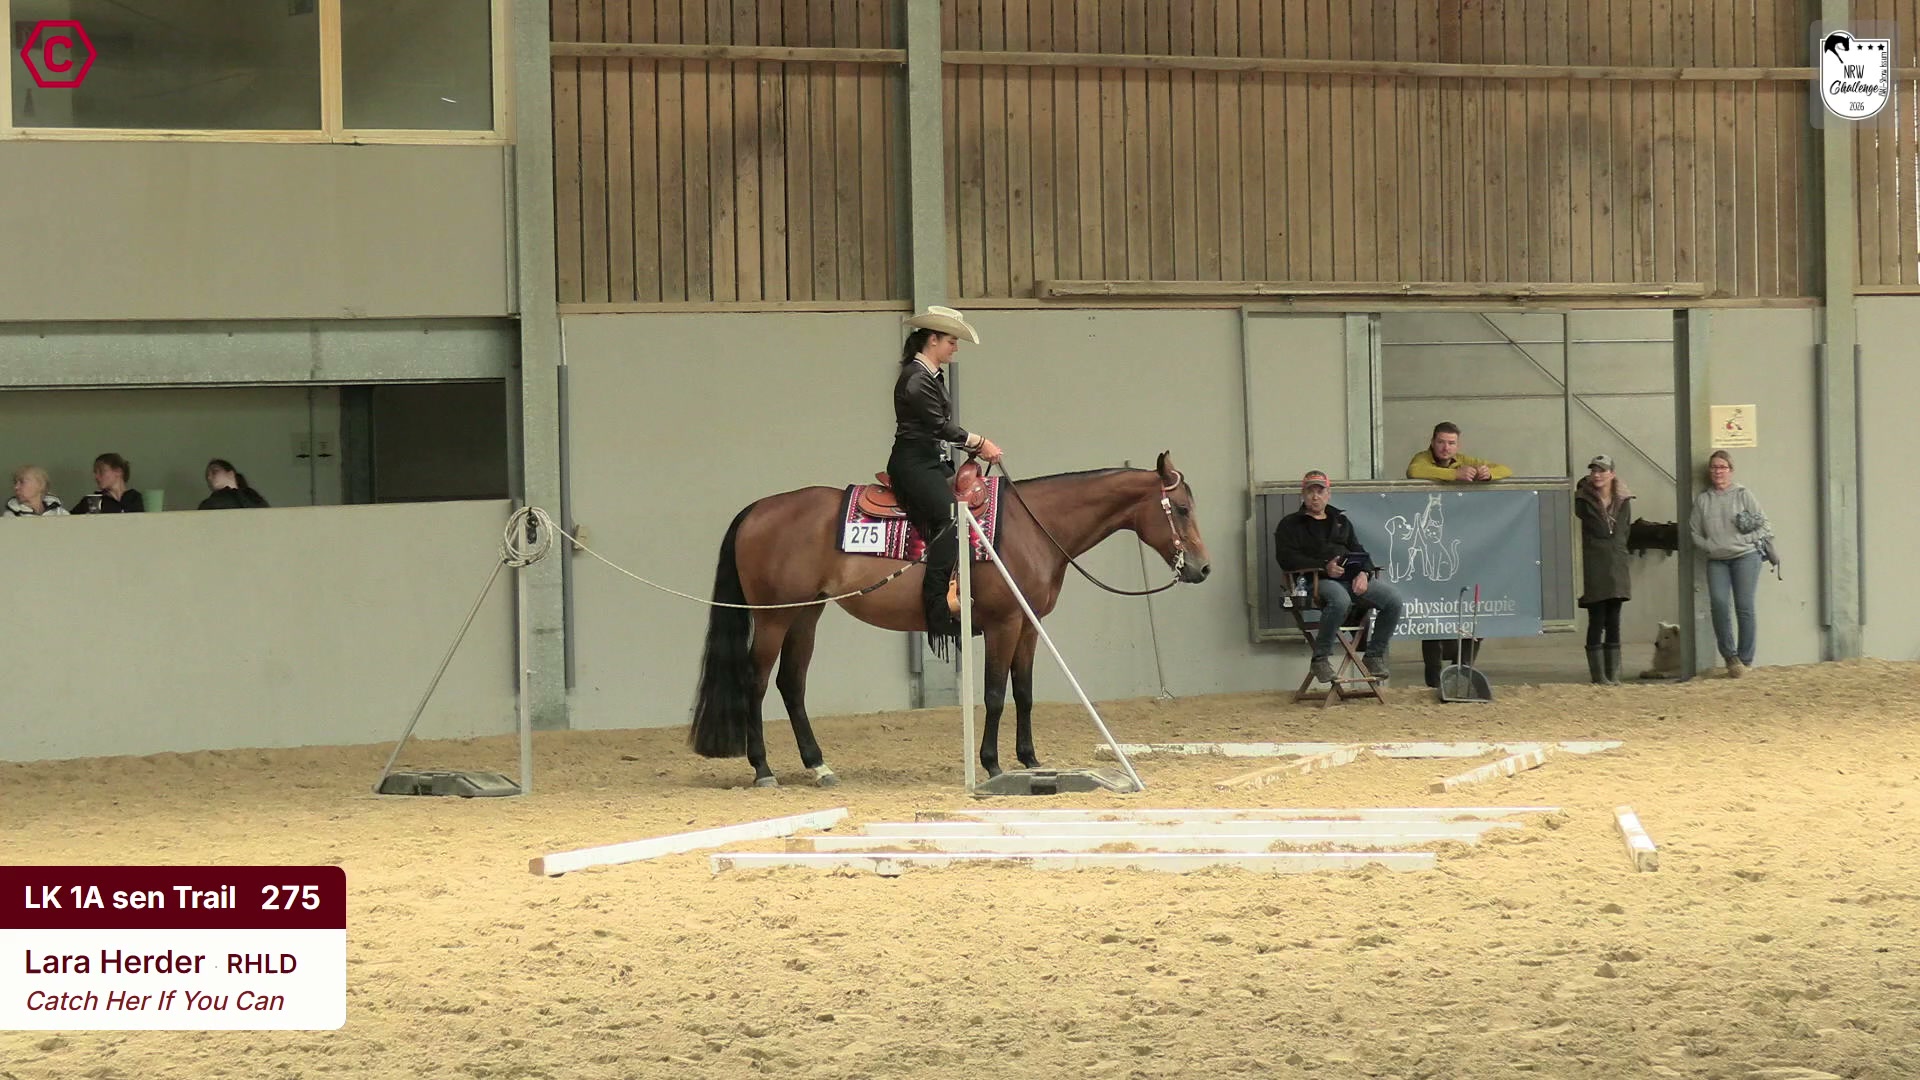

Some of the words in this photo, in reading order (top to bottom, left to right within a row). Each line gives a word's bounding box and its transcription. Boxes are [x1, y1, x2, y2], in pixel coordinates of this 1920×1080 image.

[851, 526, 879, 544] 275
[1368, 594, 1517, 618] physiotherapie
[1370, 618, 1478, 636] eckenheuer
